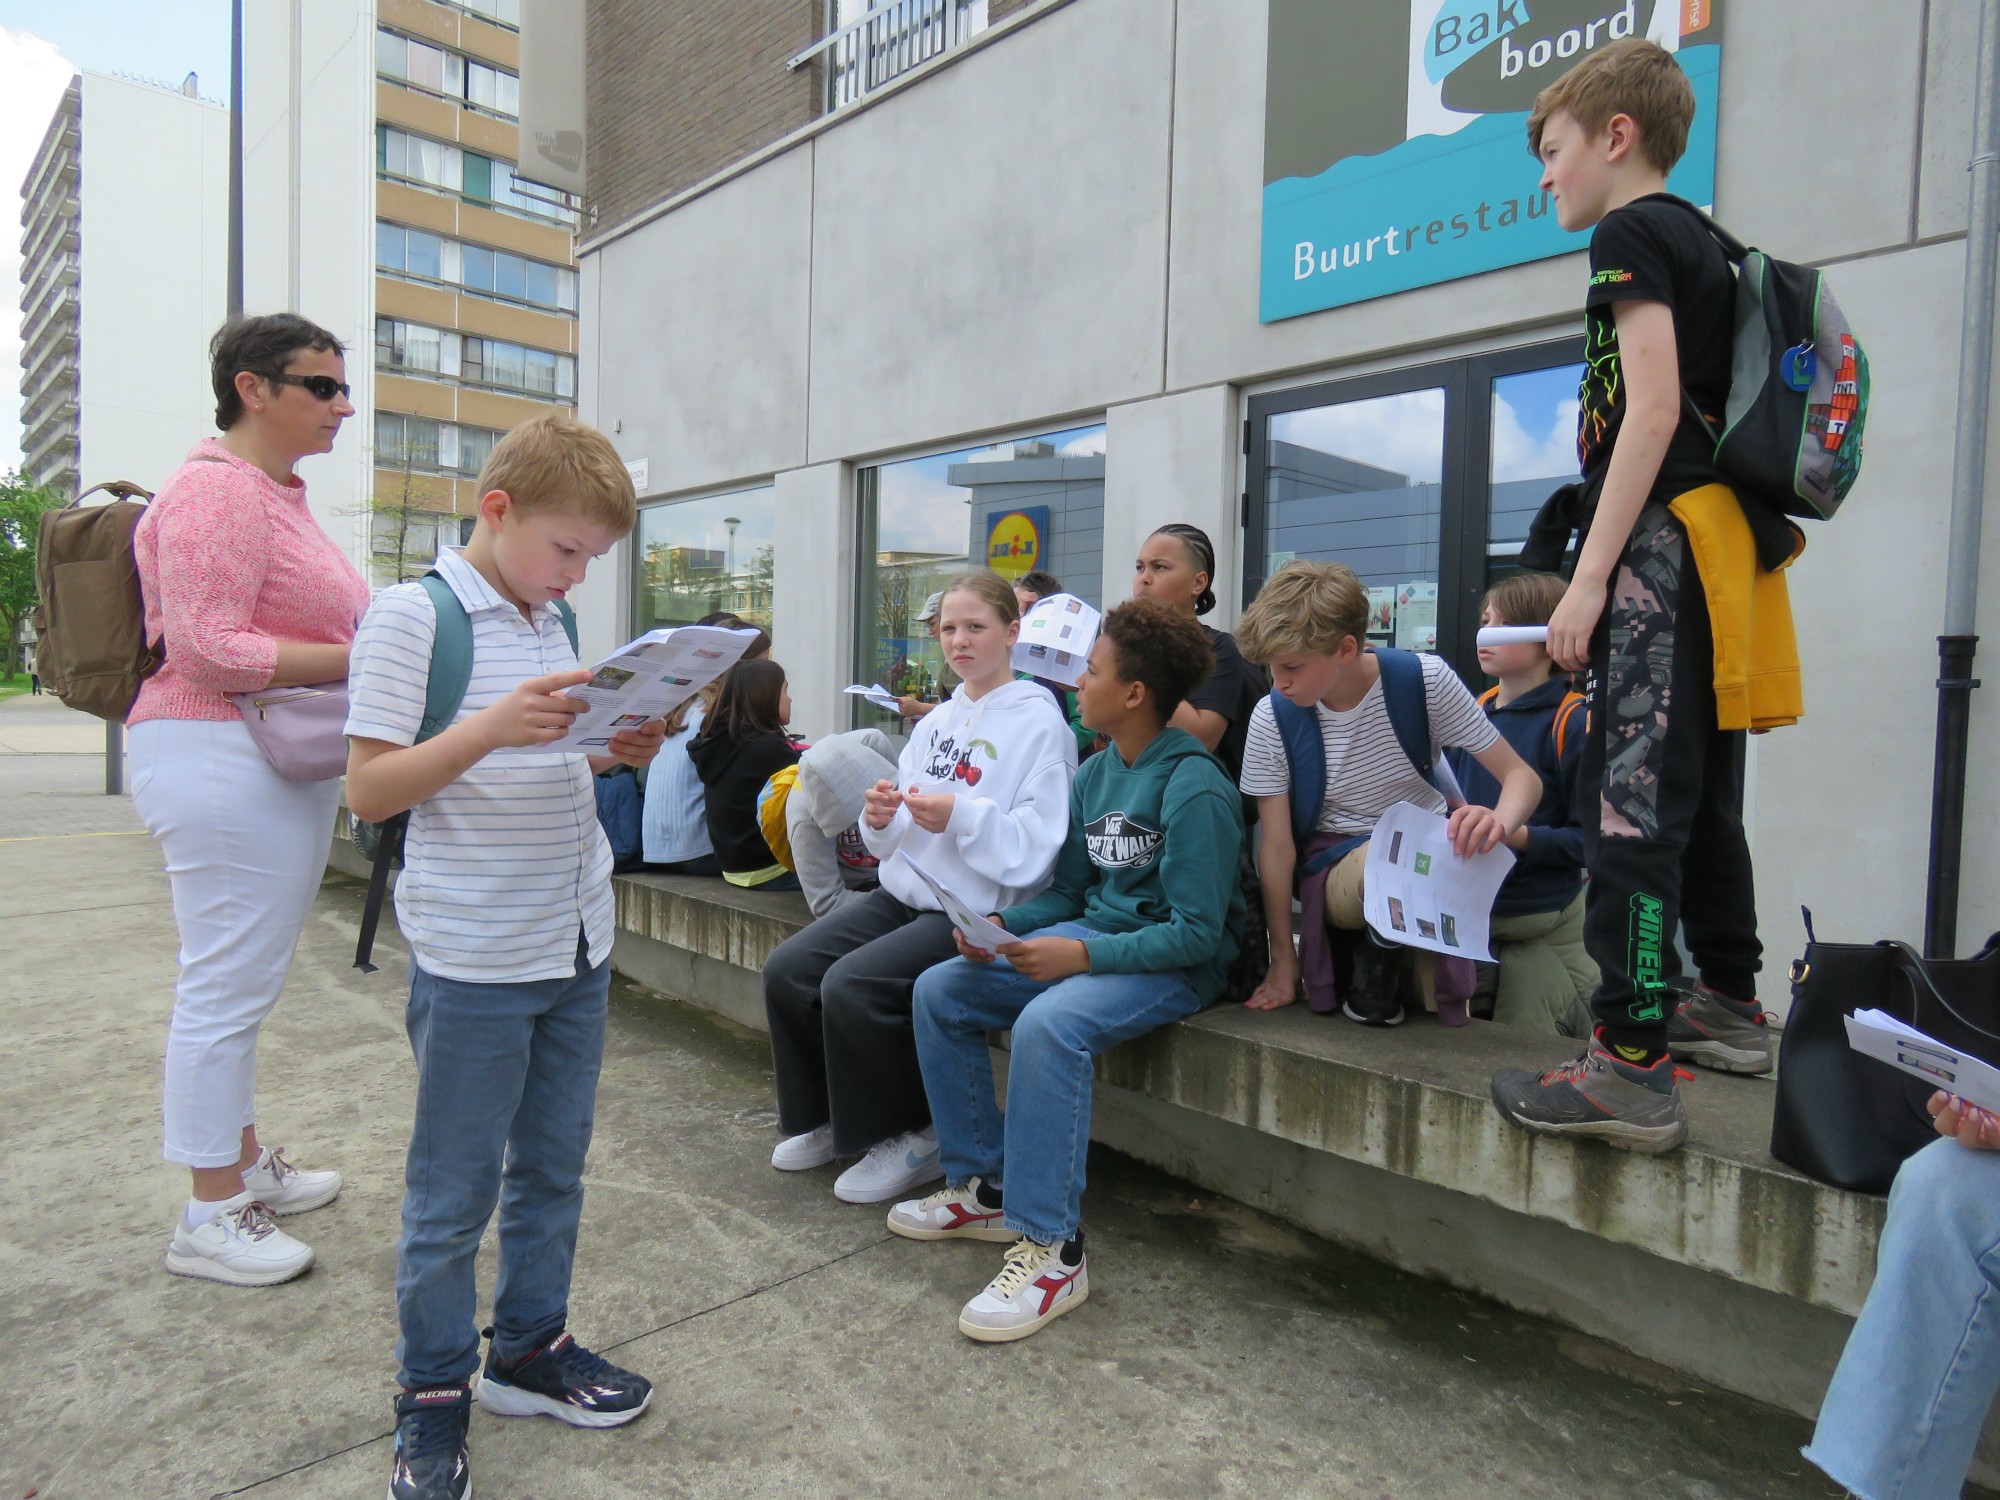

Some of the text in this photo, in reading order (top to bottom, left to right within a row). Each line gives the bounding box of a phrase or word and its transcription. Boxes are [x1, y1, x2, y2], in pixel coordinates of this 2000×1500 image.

[1435, 0, 1520, 57] Bak
[1500, 0, 1635, 80] boord
[1294, 190, 1548, 281] Buurtrestau
[1837, 383, 1854, 394] TNT
[415, 1390, 463, 1400] SKECHERS
